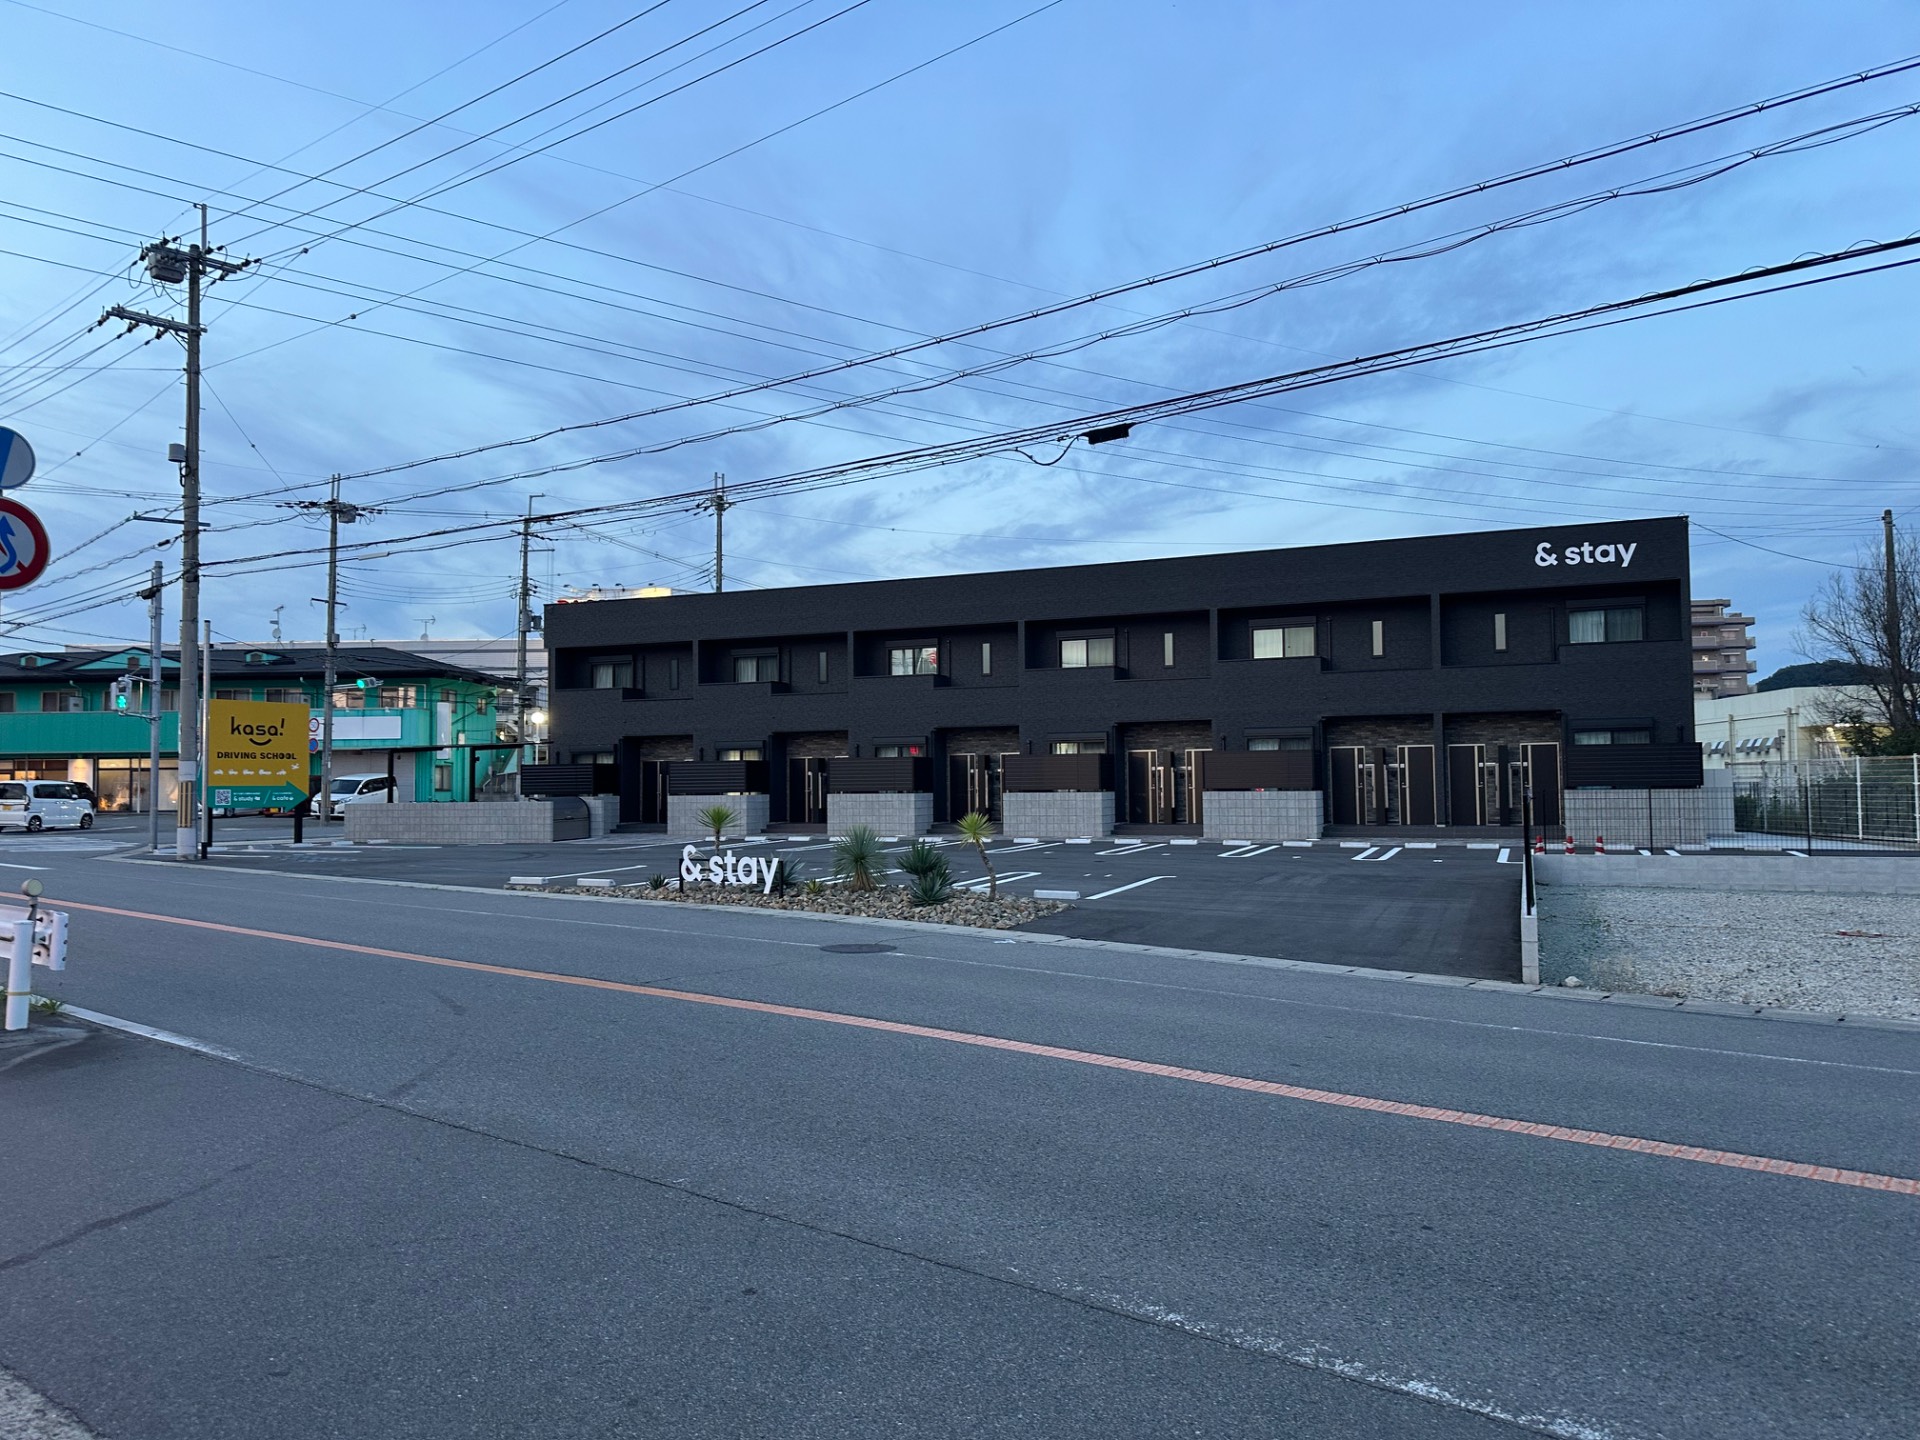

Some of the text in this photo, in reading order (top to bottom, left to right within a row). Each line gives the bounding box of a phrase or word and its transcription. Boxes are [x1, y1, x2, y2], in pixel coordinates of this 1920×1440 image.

[1534, 541, 1638, 568] & stay
[231, 716, 285, 736] kasa!
[217, 751, 297, 760] DRIVING SCHOOL
[681, 844, 779, 894] & stay
